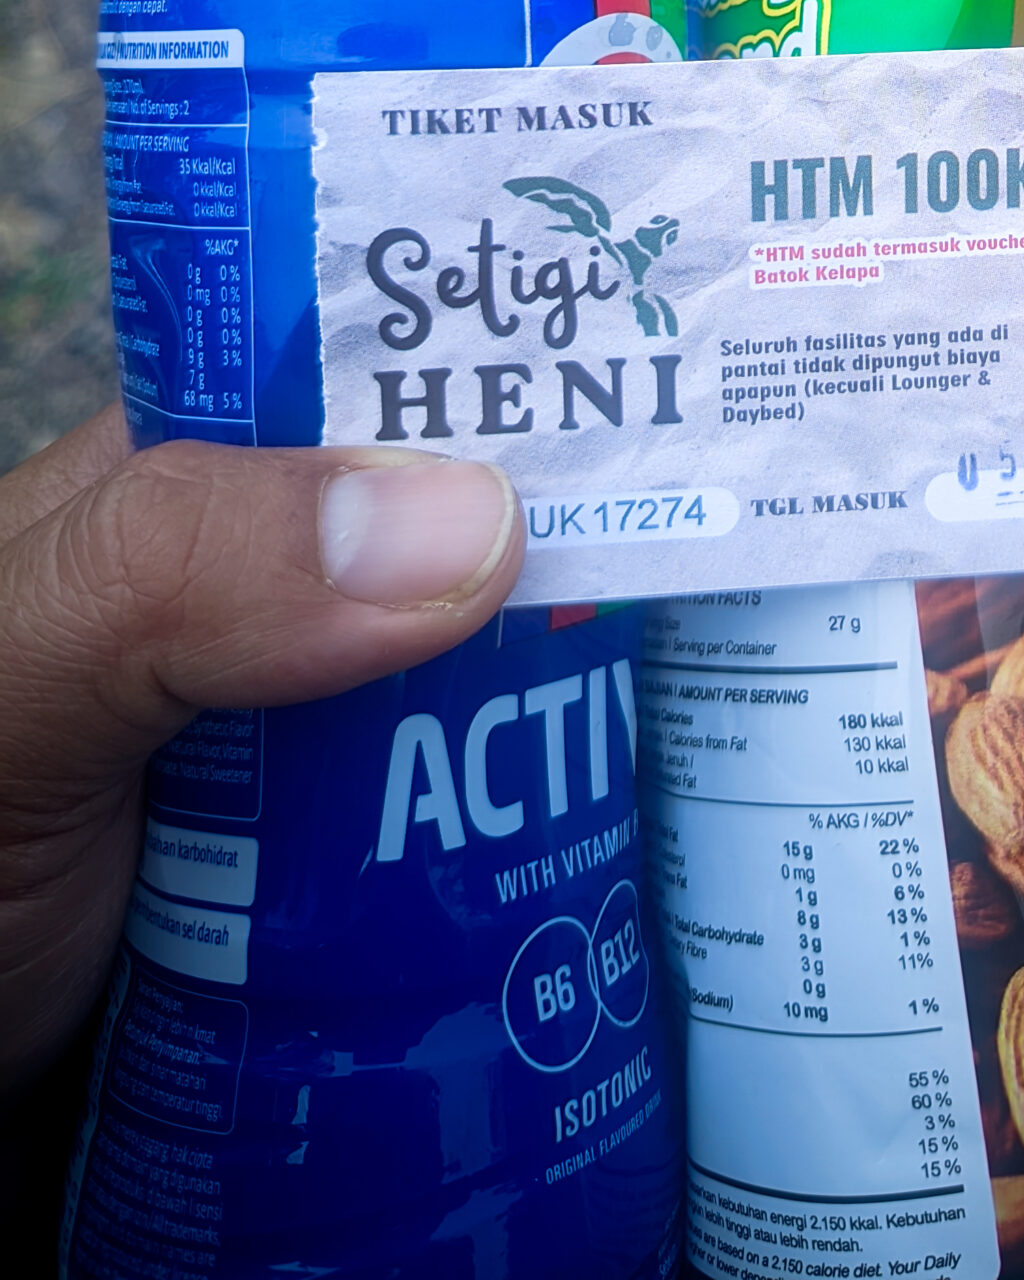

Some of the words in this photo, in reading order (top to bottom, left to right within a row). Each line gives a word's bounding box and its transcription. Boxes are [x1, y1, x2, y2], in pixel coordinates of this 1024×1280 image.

[159, 40, 229, 60] INFORMATION
[382, 108, 501, 136] TIKET
[516, 101, 654, 132] MASUK
[153, 136, 190, 153] SERVING
[180, 158, 190, 175] 35
[750, 154, 874, 222] HTM
[811, 242, 867, 261] sudah
[873, 237, 961, 257] termasuk
[366, 218, 621, 350] Setigi
[754, 266, 809, 285] Batok
[815, 264, 880, 285] Kelapa
[720, 337, 798, 356] Seluruh
[804, 331, 887, 352] fasilitas
[893, 332, 940, 351] yang
[947, 326, 984, 344] ada
[990, 324, 1009, 342] di
[720, 359, 786, 382] pantai
[793, 355, 846, 374] tidak
[852, 351, 941, 375] dipungut
[947, 348, 1001, 368] biaya
[373, 354, 684, 441] HENI
[721, 383, 797, 405] apapun
[803, 376, 885, 399] (kecuali
[891, 370, 971, 394] Lounger
[977, 370, 992, 386] &
[722, 402, 806, 426] Daybed)
[751, 495, 804, 517] TGL
[812, 490, 908, 515] MASUK
[529, 494, 707, 538] UK17274
[828, 615, 845, 632] 27
[673, 638, 705, 657] Serving
[706, 641, 725, 657] per
[725, 639, 778, 657] Container
[678, 683, 722, 701] AMOUNT
[724, 687, 748, 703] PER
[750, 687, 809, 705] SERVING
[838, 714, 867, 730] 180
[870, 711, 904, 728] kkal
[706, 734, 728, 750] from
[730, 736, 748, 752] Fat
[844, 736, 871, 753] 130
[875, 734, 906, 750] kkal
[855, 759, 874, 775] 10
[878, 756, 909, 773] kkal
[826, 812, 860, 829] AKG
[177, 837, 239, 868] karbohidrat
[783, 841, 801, 857] 15
[879, 839, 900, 855] 22
[494, 855, 557, 905] WITH
[561, 816, 631, 879] VITAMIN
[793, 868, 815, 884] mg
[887, 908, 908, 925] 13
[182, 920, 196, 940] sel
[197, 921, 230, 947] darah
[691, 917, 765, 946] Carbohydrate
[600, 919, 641, 987] B12
[687, 940, 708, 959] Fibre
[898, 952, 934, 970] 11%
[533, 964, 577, 1022] B6
[783, 1002, 801, 1018] 10
[804, 1005, 828, 1022] mg
[909, 1072, 929, 1089] 55
[554, 1046, 652, 1143] ISOTONIC
[911, 1093, 932, 1110] 60
[545, 1141, 598, 1185] ORIGINAL
[599, 1110, 645, 1157] FLAVOURED
[918, 1137, 938, 1154] 15
[921, 1160, 941, 1178] 15
[718, 1193, 768, 1223] kebutuhan
[770, 1212, 807, 1232] energi
[849, 1215, 883, 1231] kkal.
[886, 1207, 966, 1229] Kebutuhan
[726, 1218, 752, 1240] tinggi
[754, 1228, 778, 1245] atau
[780, 1232, 809, 1250] lebih
[811, 1237, 863, 1253] rendah.
[718, 1237, 745, 1261] based
[746, 1250, 760, 1263] on
[806, 1260, 851, 1279] calorie
[888, 1259, 922, 1277] Your
[924, 1250, 962, 1271] Daily
